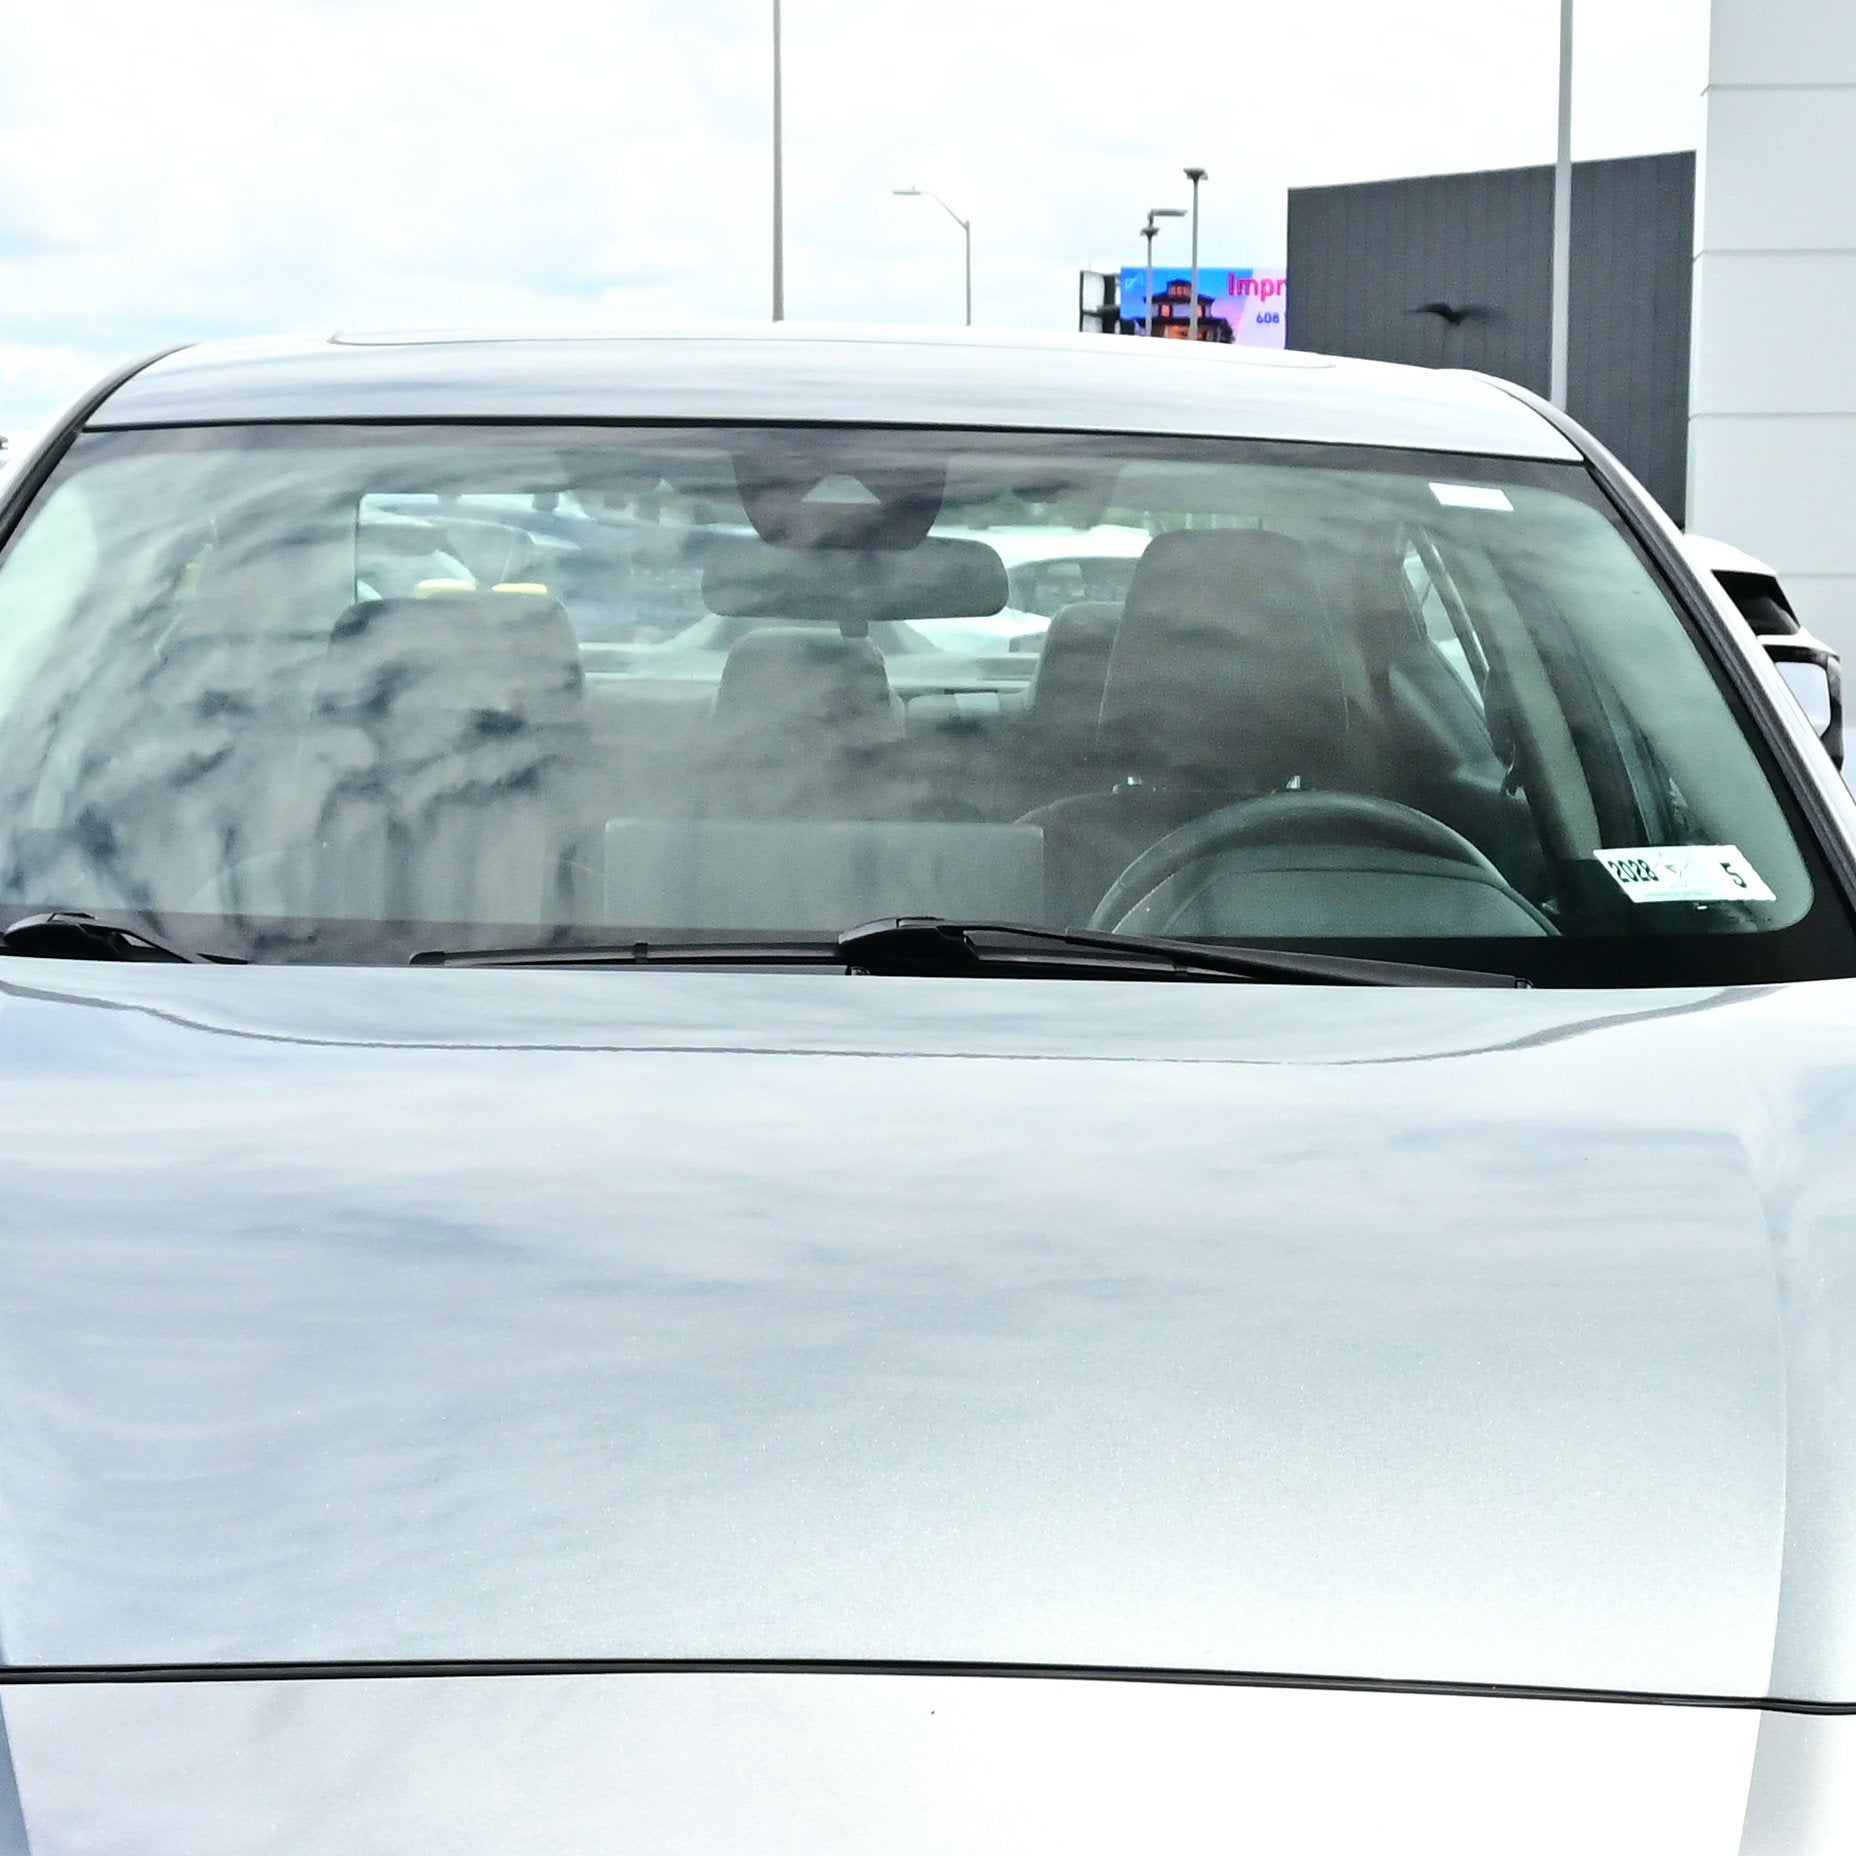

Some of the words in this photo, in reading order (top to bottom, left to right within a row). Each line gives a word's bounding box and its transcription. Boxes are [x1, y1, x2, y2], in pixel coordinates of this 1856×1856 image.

[1256, 312, 1280, 324] 608
[1607, 858, 1659, 883] 2028
[1719, 862, 1748, 889] 5
